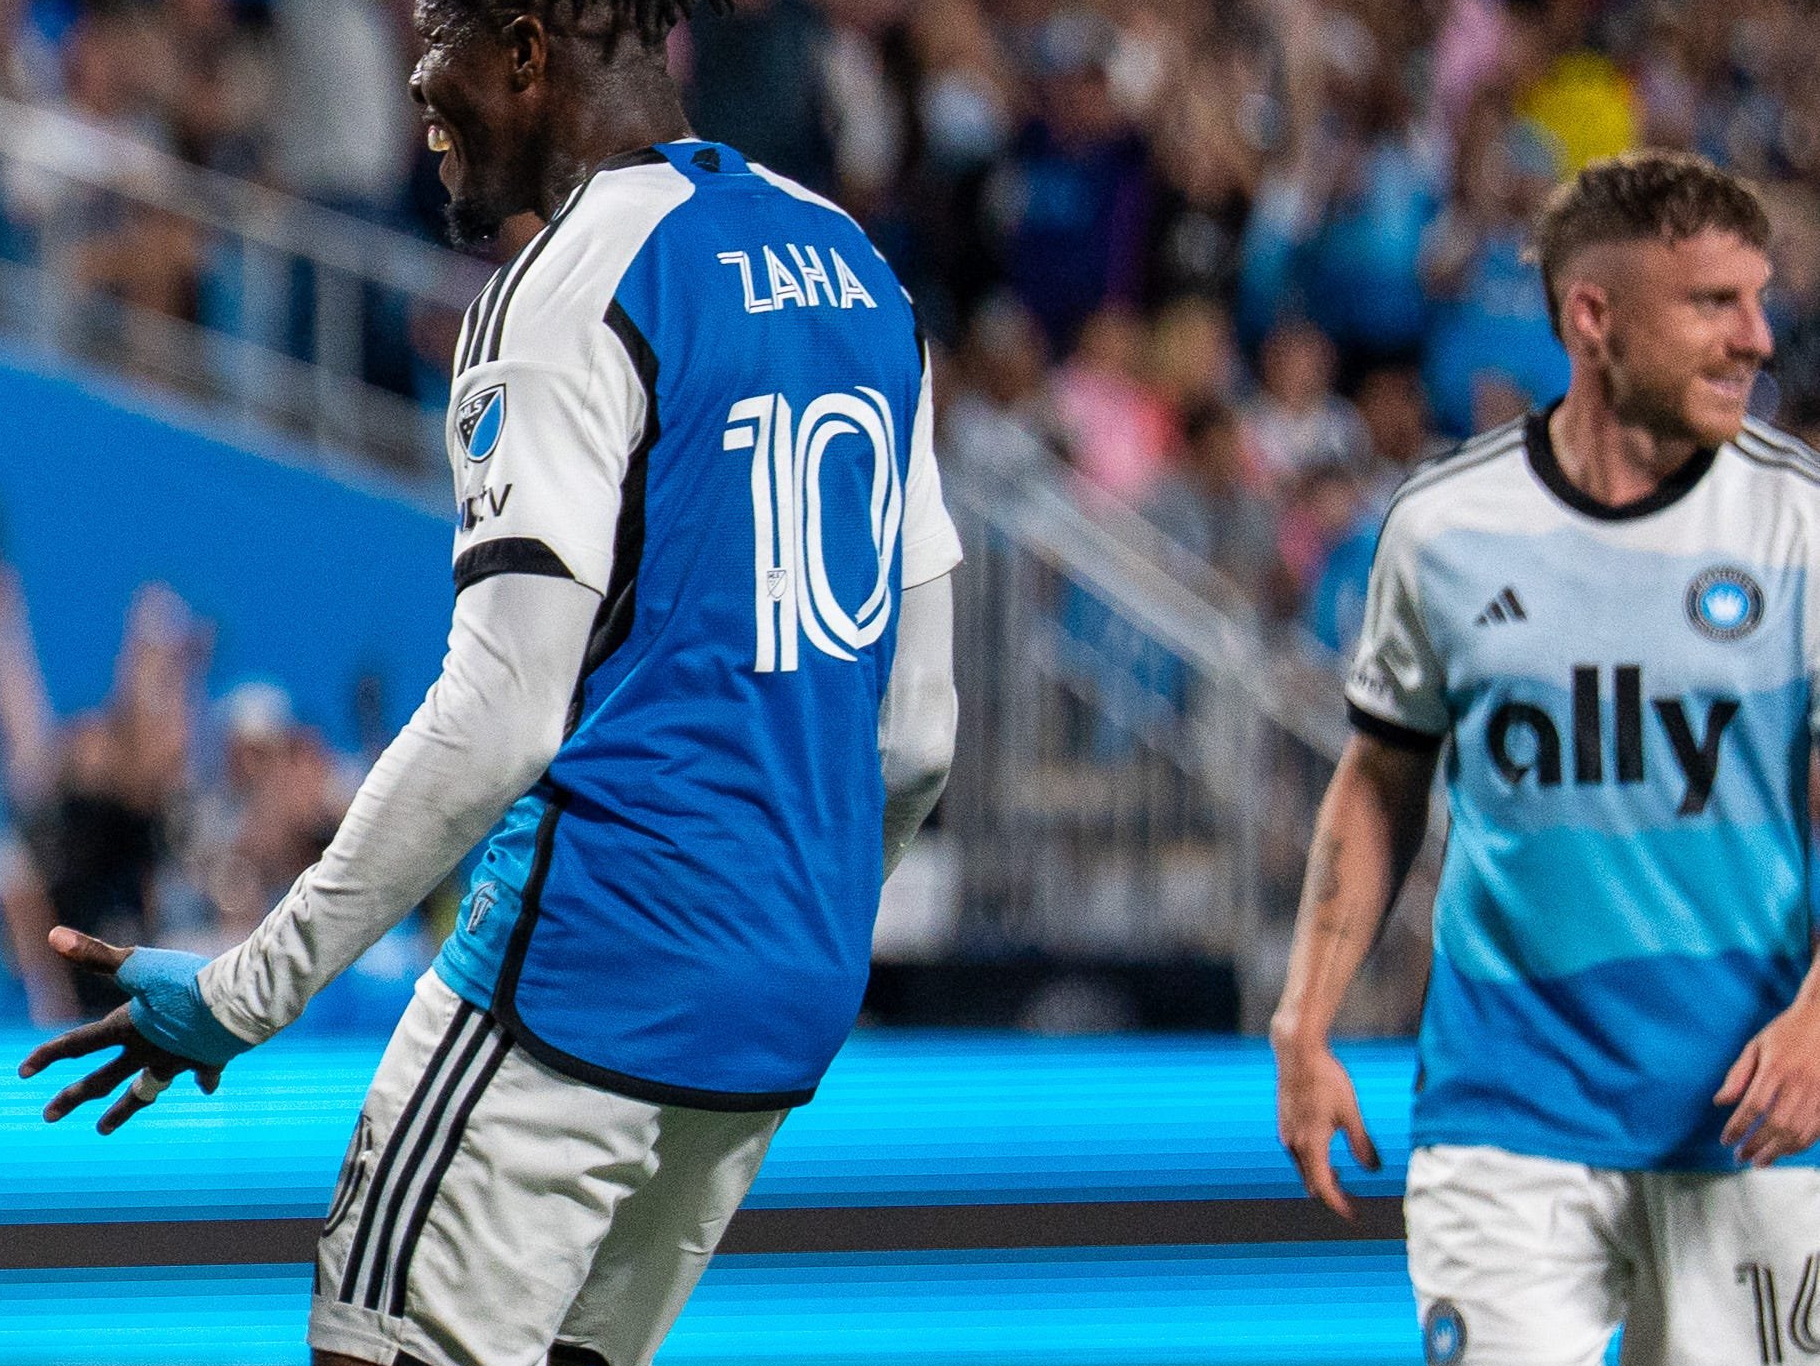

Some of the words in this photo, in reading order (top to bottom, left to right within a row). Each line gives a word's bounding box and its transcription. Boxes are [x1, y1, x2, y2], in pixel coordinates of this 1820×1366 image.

[717, 243, 877, 314] ZAHA
[723, 385, 903, 673] 10
[1486, 664, 1741, 818] ally
